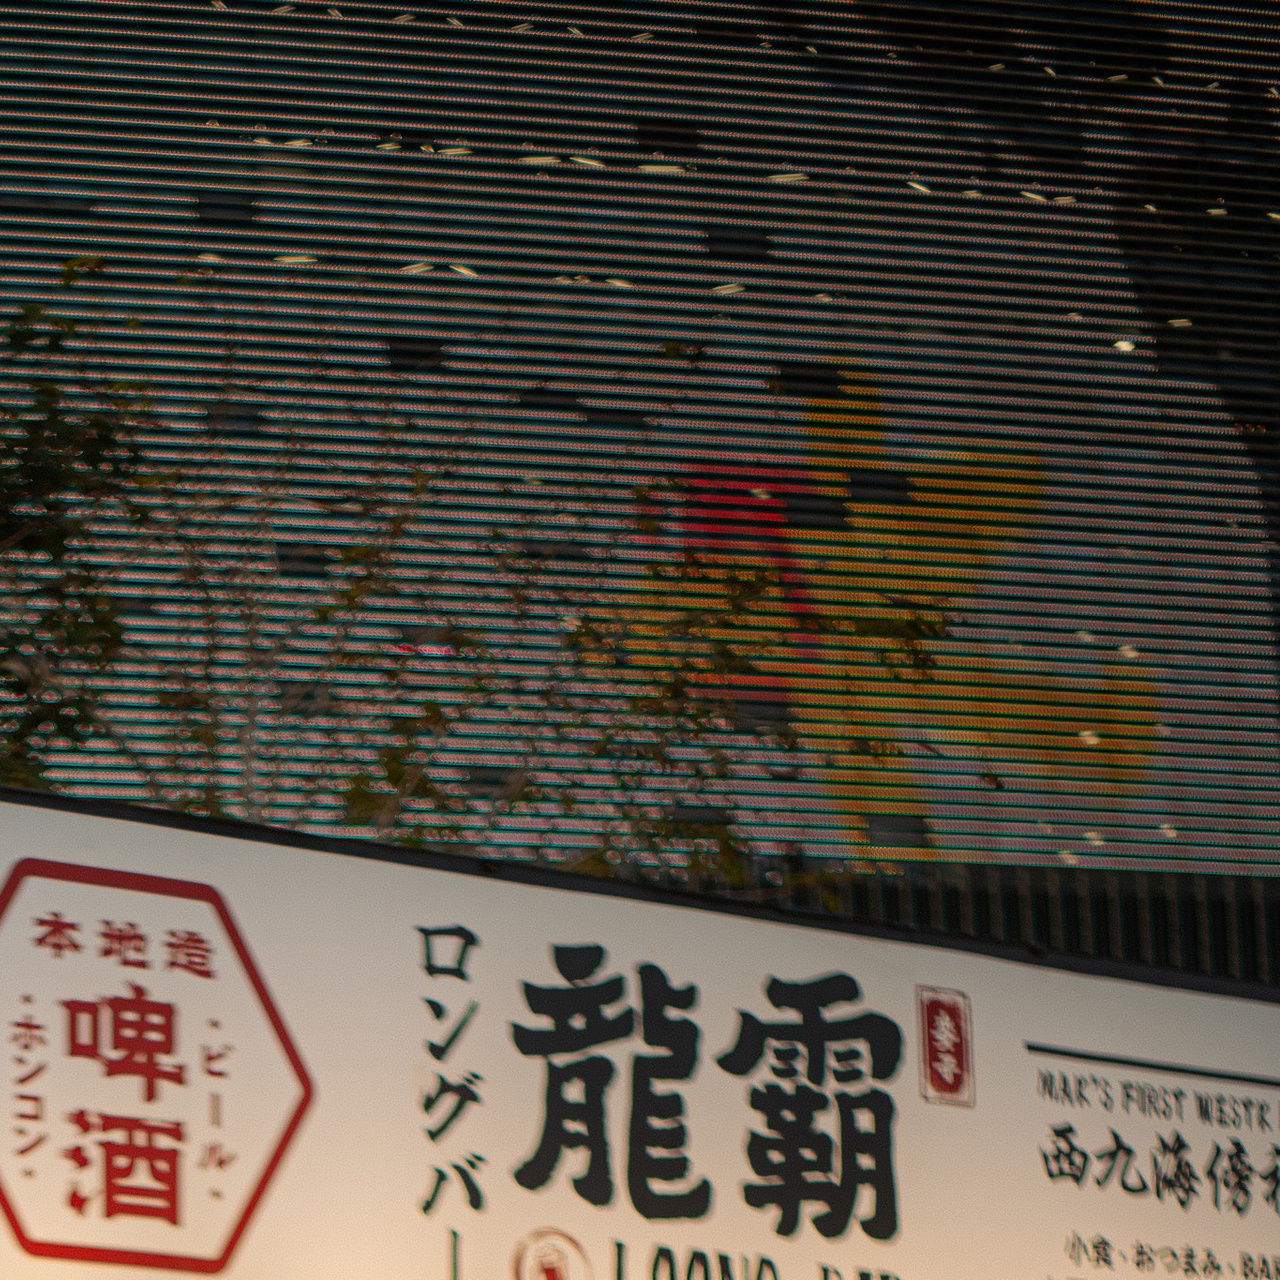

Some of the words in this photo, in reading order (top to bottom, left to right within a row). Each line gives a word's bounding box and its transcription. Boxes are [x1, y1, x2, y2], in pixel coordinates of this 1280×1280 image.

[31, 911, 217, 980] 本地造
[61, 981, 187, 1227] 啤酒
[509, 942, 907, 1243] 龍霸
